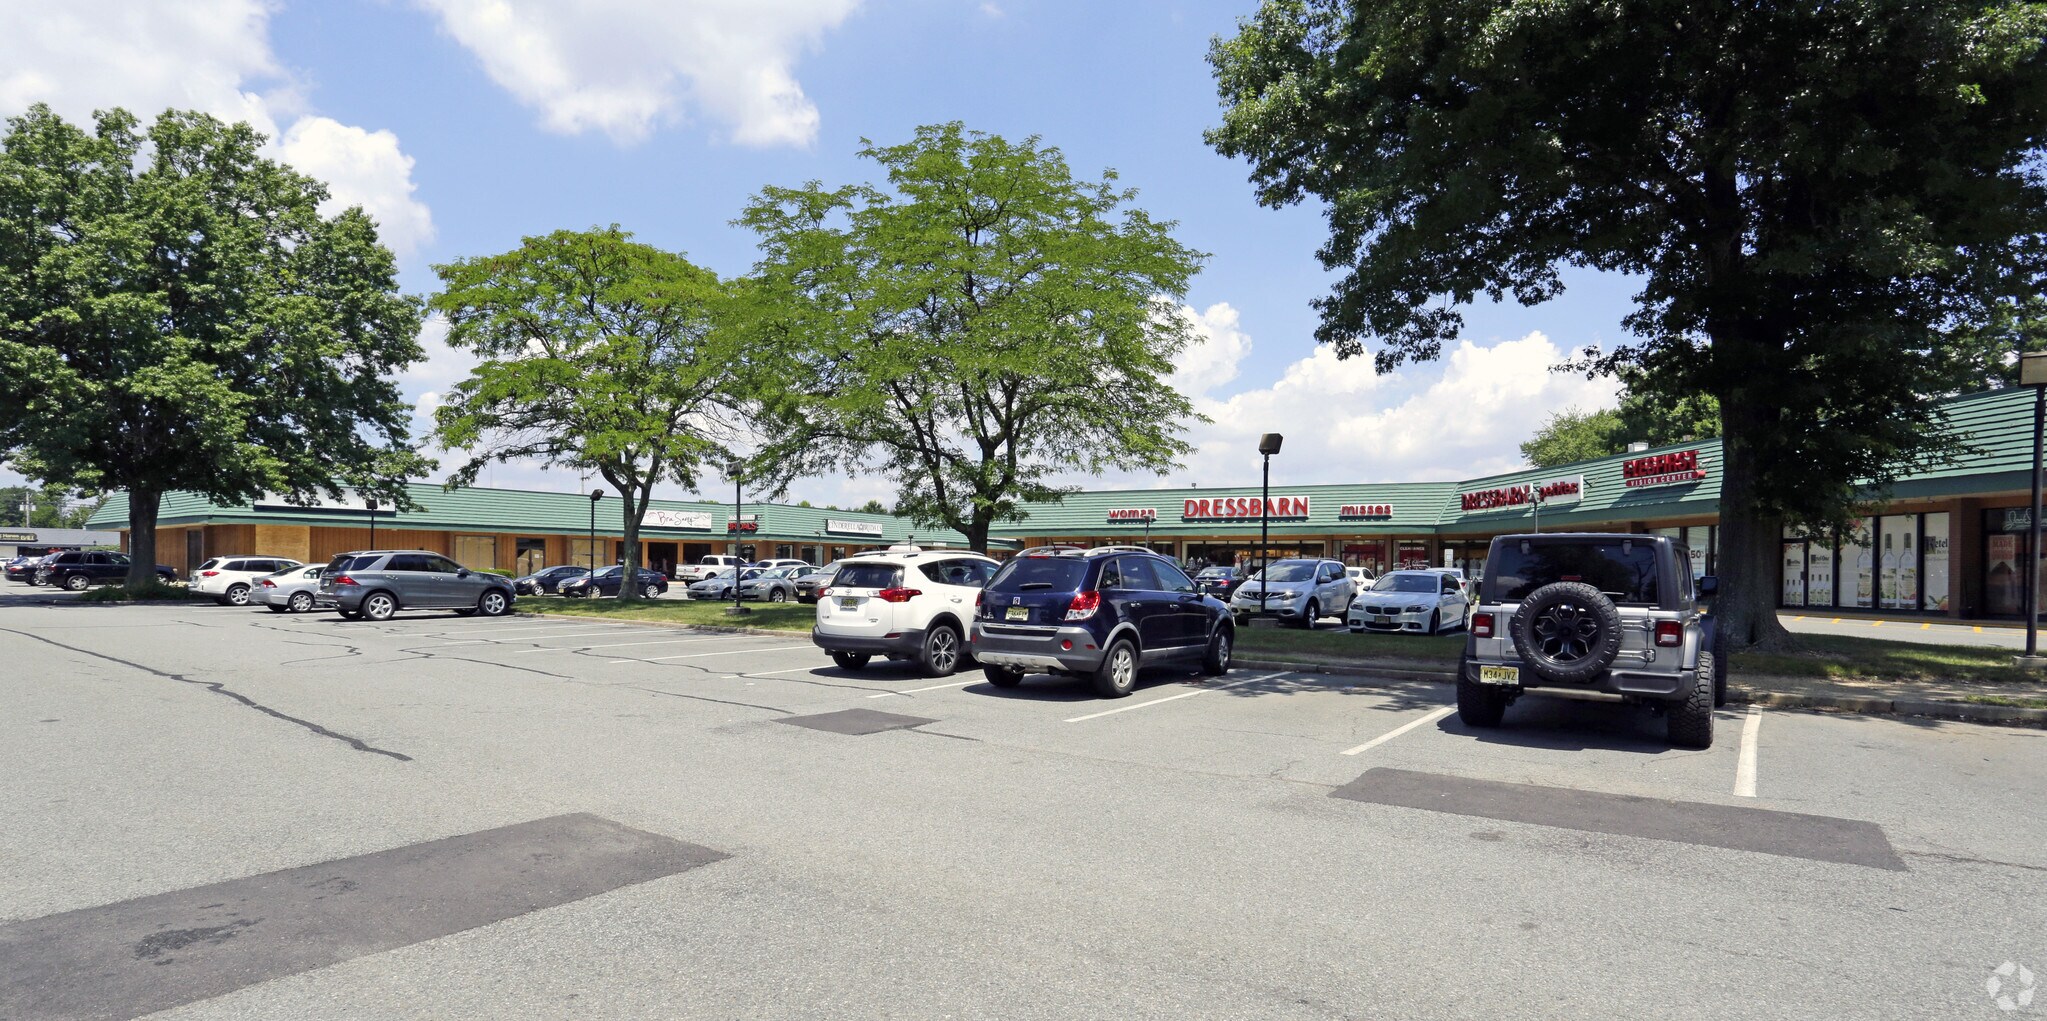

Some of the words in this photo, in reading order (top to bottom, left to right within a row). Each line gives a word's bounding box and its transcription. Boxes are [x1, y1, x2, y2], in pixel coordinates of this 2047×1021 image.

[1623, 450, 1700, 478] EYESFIRST
[1630, 478, 1658, 487] VISION
[1661, 473, 1693, 483] CENTER
[1461, 485, 1530, 511] DRESSBARN
[1539, 481, 1579, 503] petites
[1108, 509, 1156, 518] woman
[1184, 497, 1308, 517] DRESSBARN
[1341, 505, 1391, 516] misses
[728, 522, 757, 531] BRDALS
